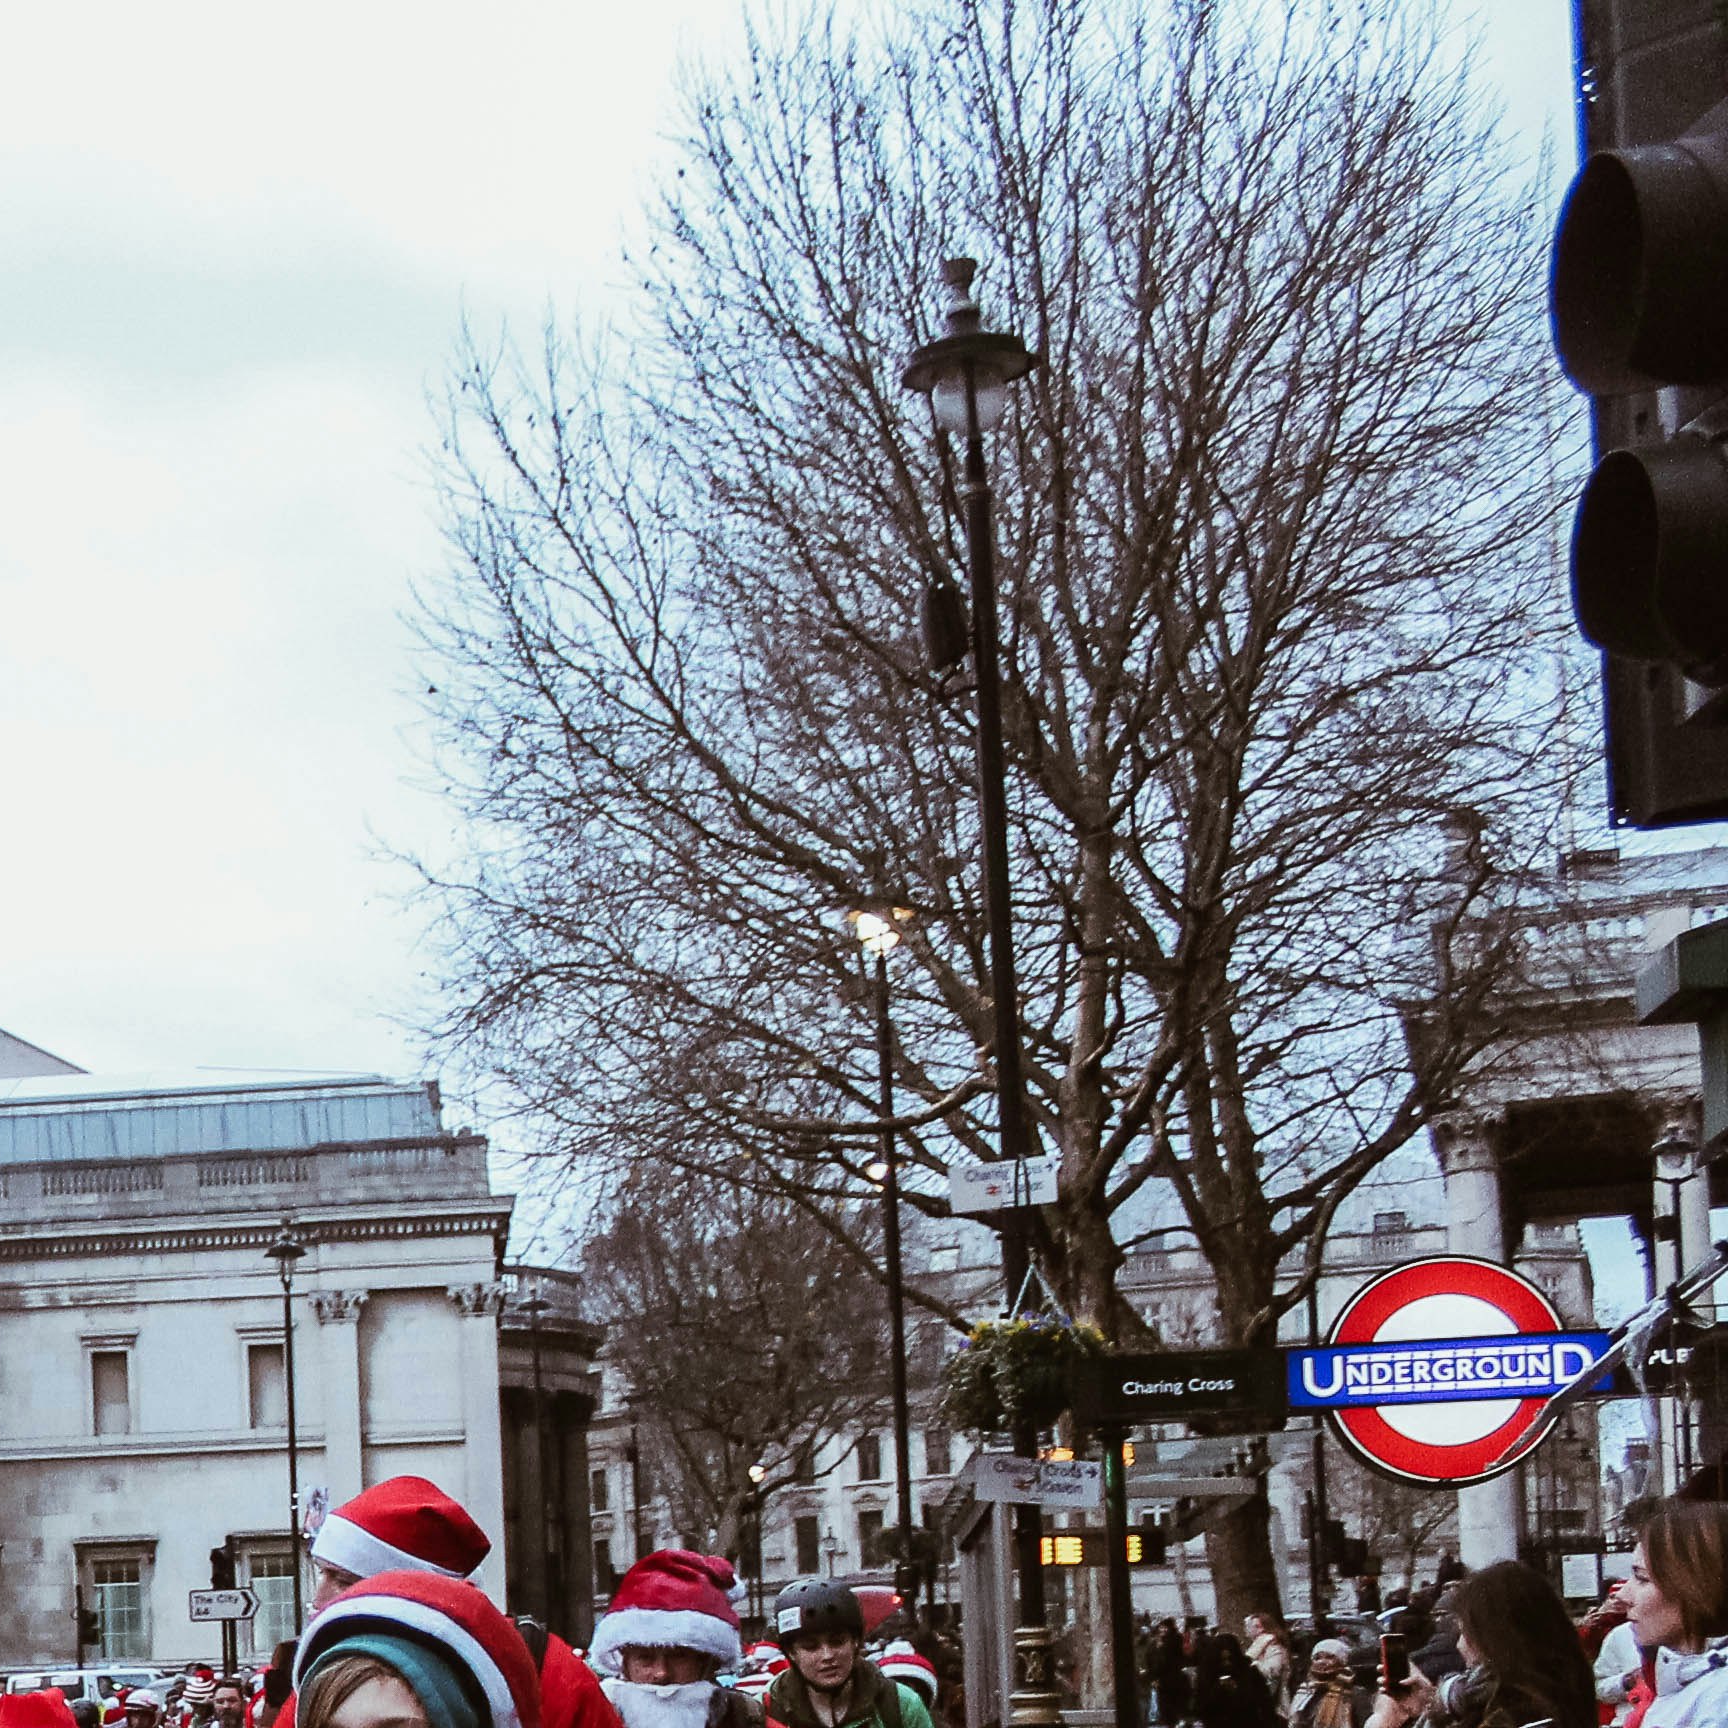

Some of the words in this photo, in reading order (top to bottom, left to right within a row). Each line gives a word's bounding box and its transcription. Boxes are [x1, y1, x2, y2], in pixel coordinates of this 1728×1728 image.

[1122, 1379, 1185, 1396] Charing
[1187, 1378, 1236, 1392] Cross
[1302, 1342, 1596, 1398] UNDERGROUND
